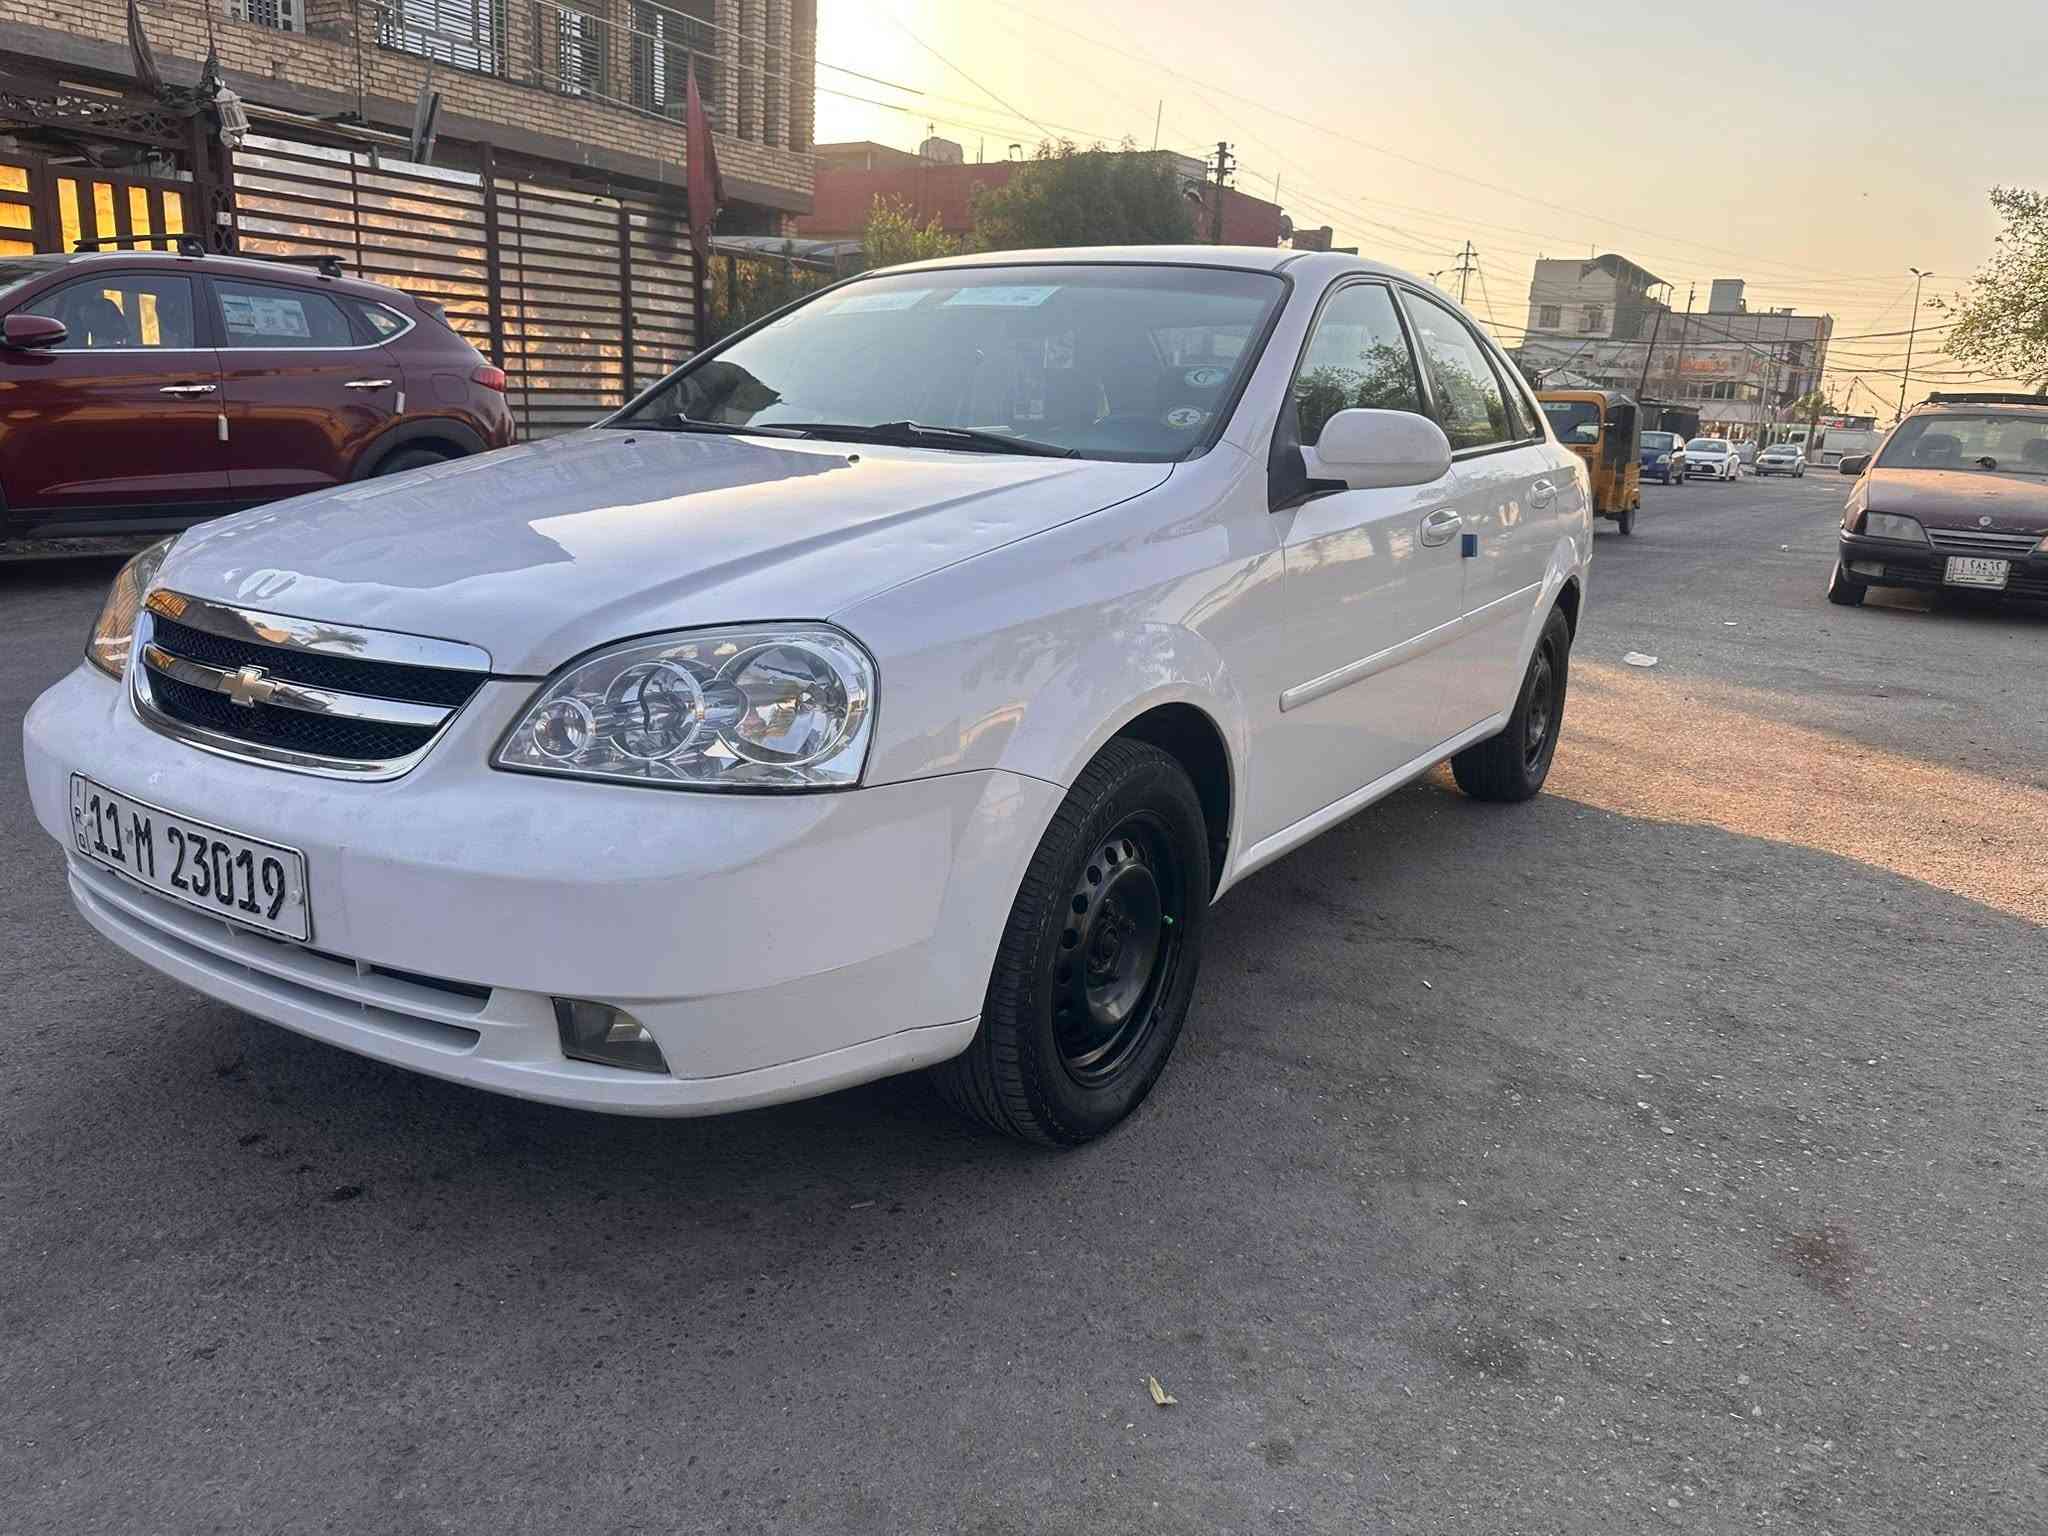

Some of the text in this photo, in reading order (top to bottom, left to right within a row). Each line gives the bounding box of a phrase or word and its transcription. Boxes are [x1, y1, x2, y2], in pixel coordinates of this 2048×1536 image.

[90, 794, 285, 920] 11 M 23019
